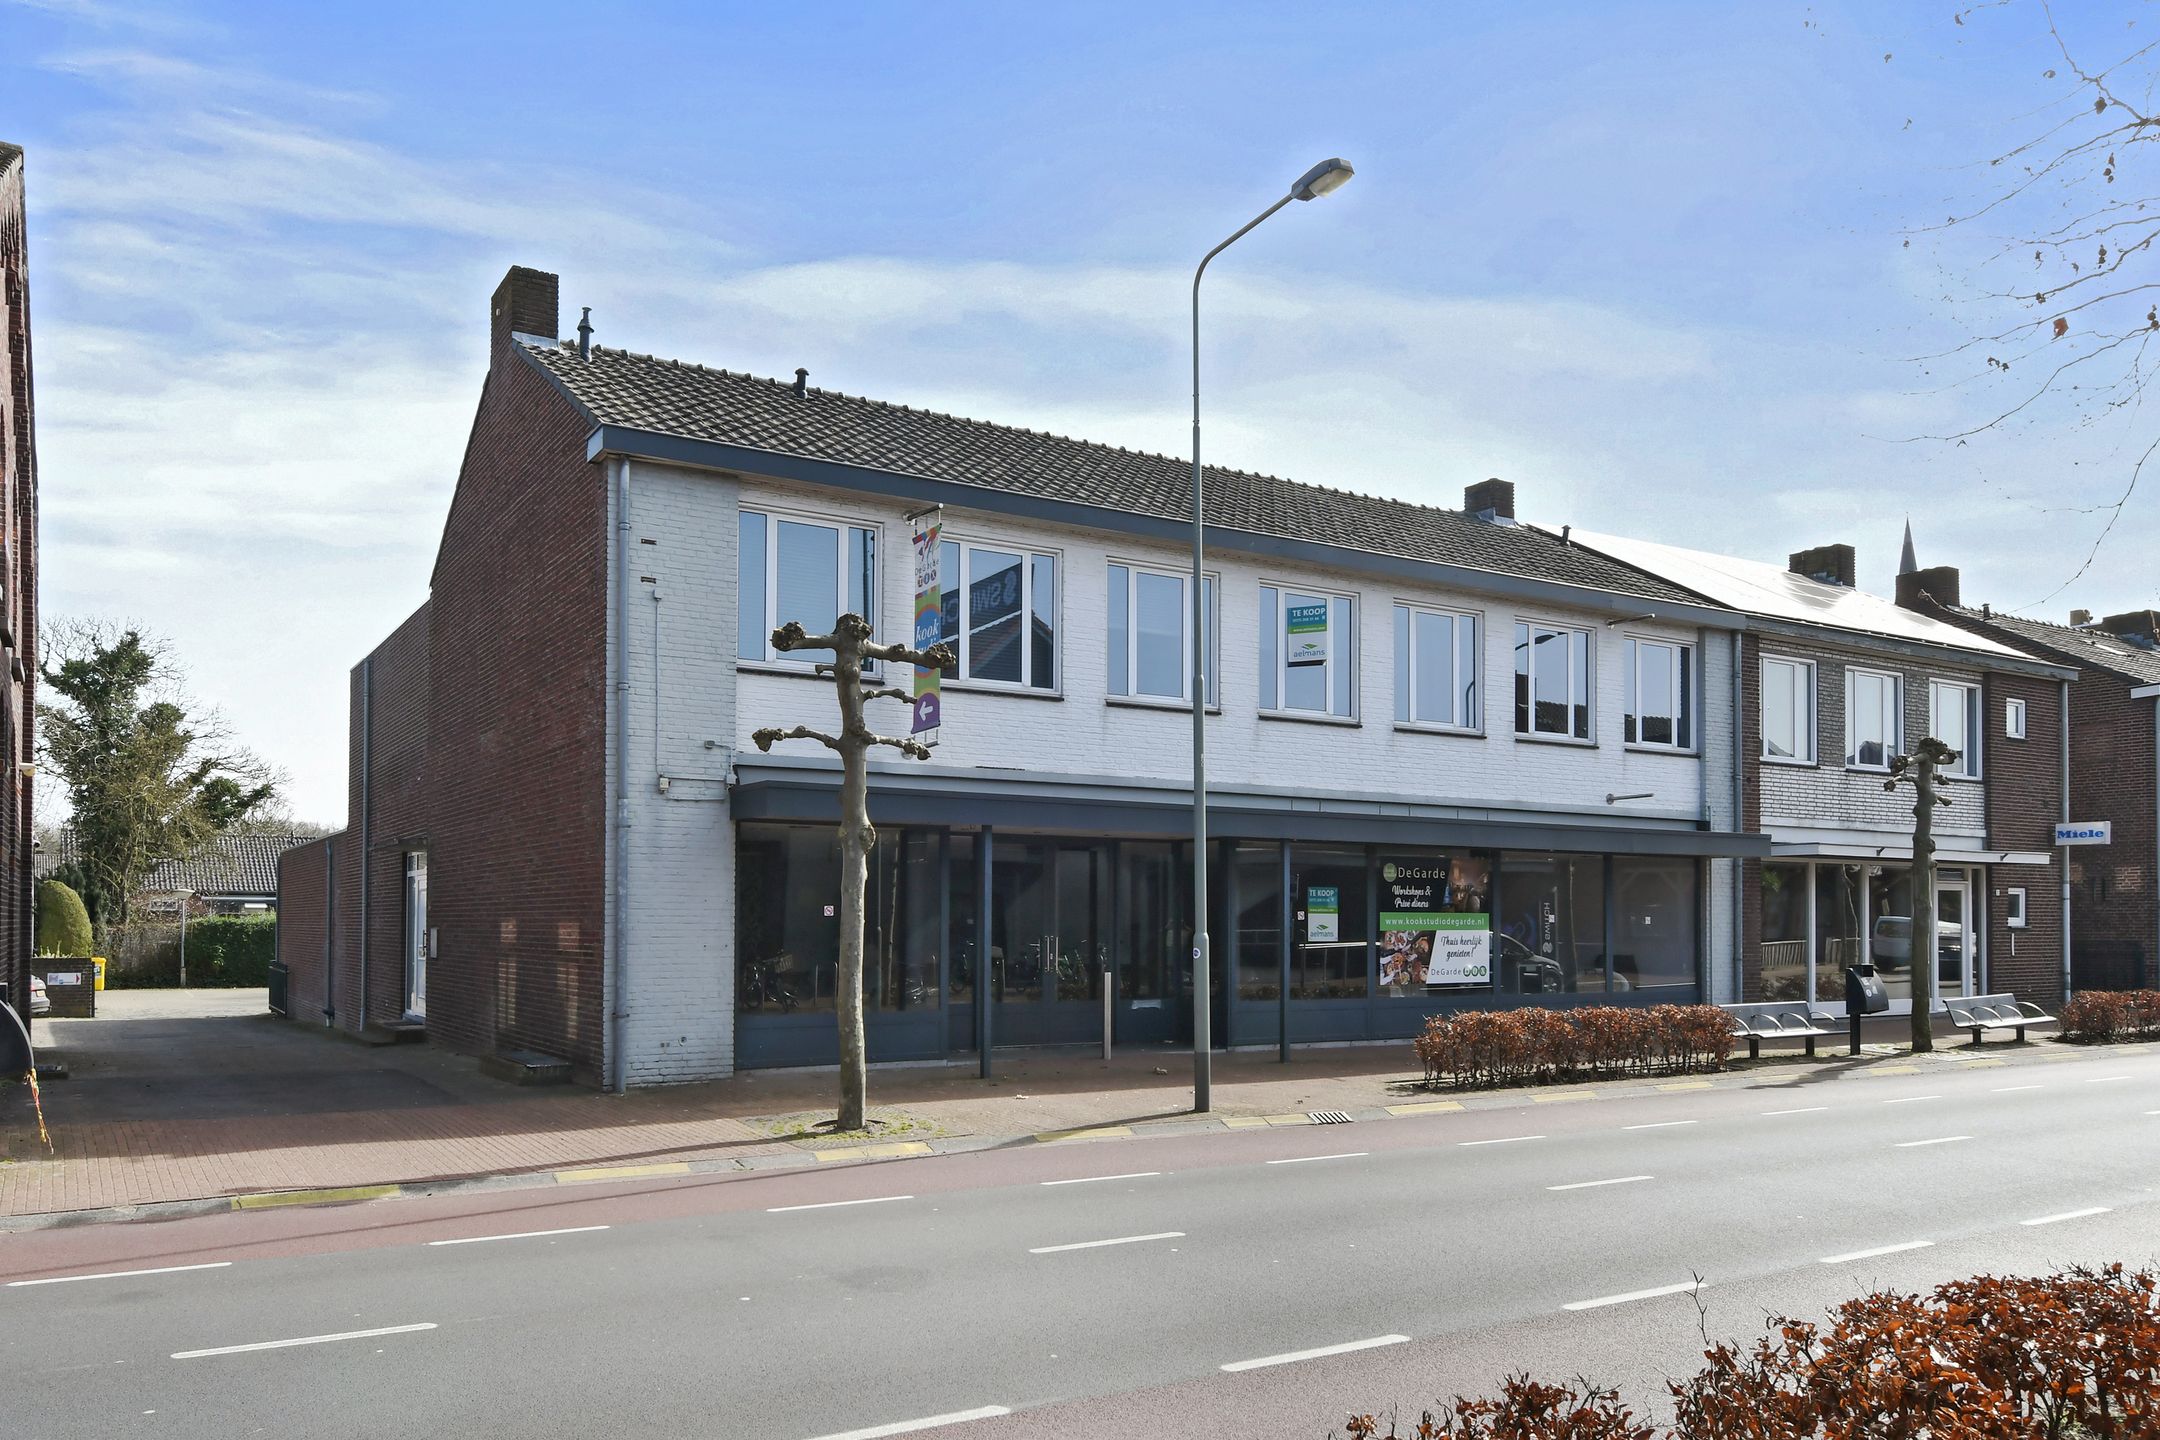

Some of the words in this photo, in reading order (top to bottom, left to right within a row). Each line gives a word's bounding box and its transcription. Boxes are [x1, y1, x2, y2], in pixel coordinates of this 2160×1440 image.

[1292, 609, 1302, 617] TE
[1303, 607, 1326, 617] KOOP
[915, 618, 940, 643] kook
[1293, 649, 1326, 658] aelmans
[2056, 829, 2105, 839] Miele
[1397, 866, 1446, 880] DeGarde
[1309, 889, 1317, 897] TE
[1317, 888, 1334, 897] KOOP
[1391, 884, 1425, 899] Workshops
[1425, 885, 1432, 896] &
[1410, 898, 1429, 908] diners
[1385, 918, 1485, 929] www.kookstudiodegarde.nl
[1440, 935, 1459, 946] Thuis
[1460, 935, 1482, 950] heerlijk
[1446, 949, 1475, 962] genieten!
[1431, 968, 1462, 976] DeGarde
